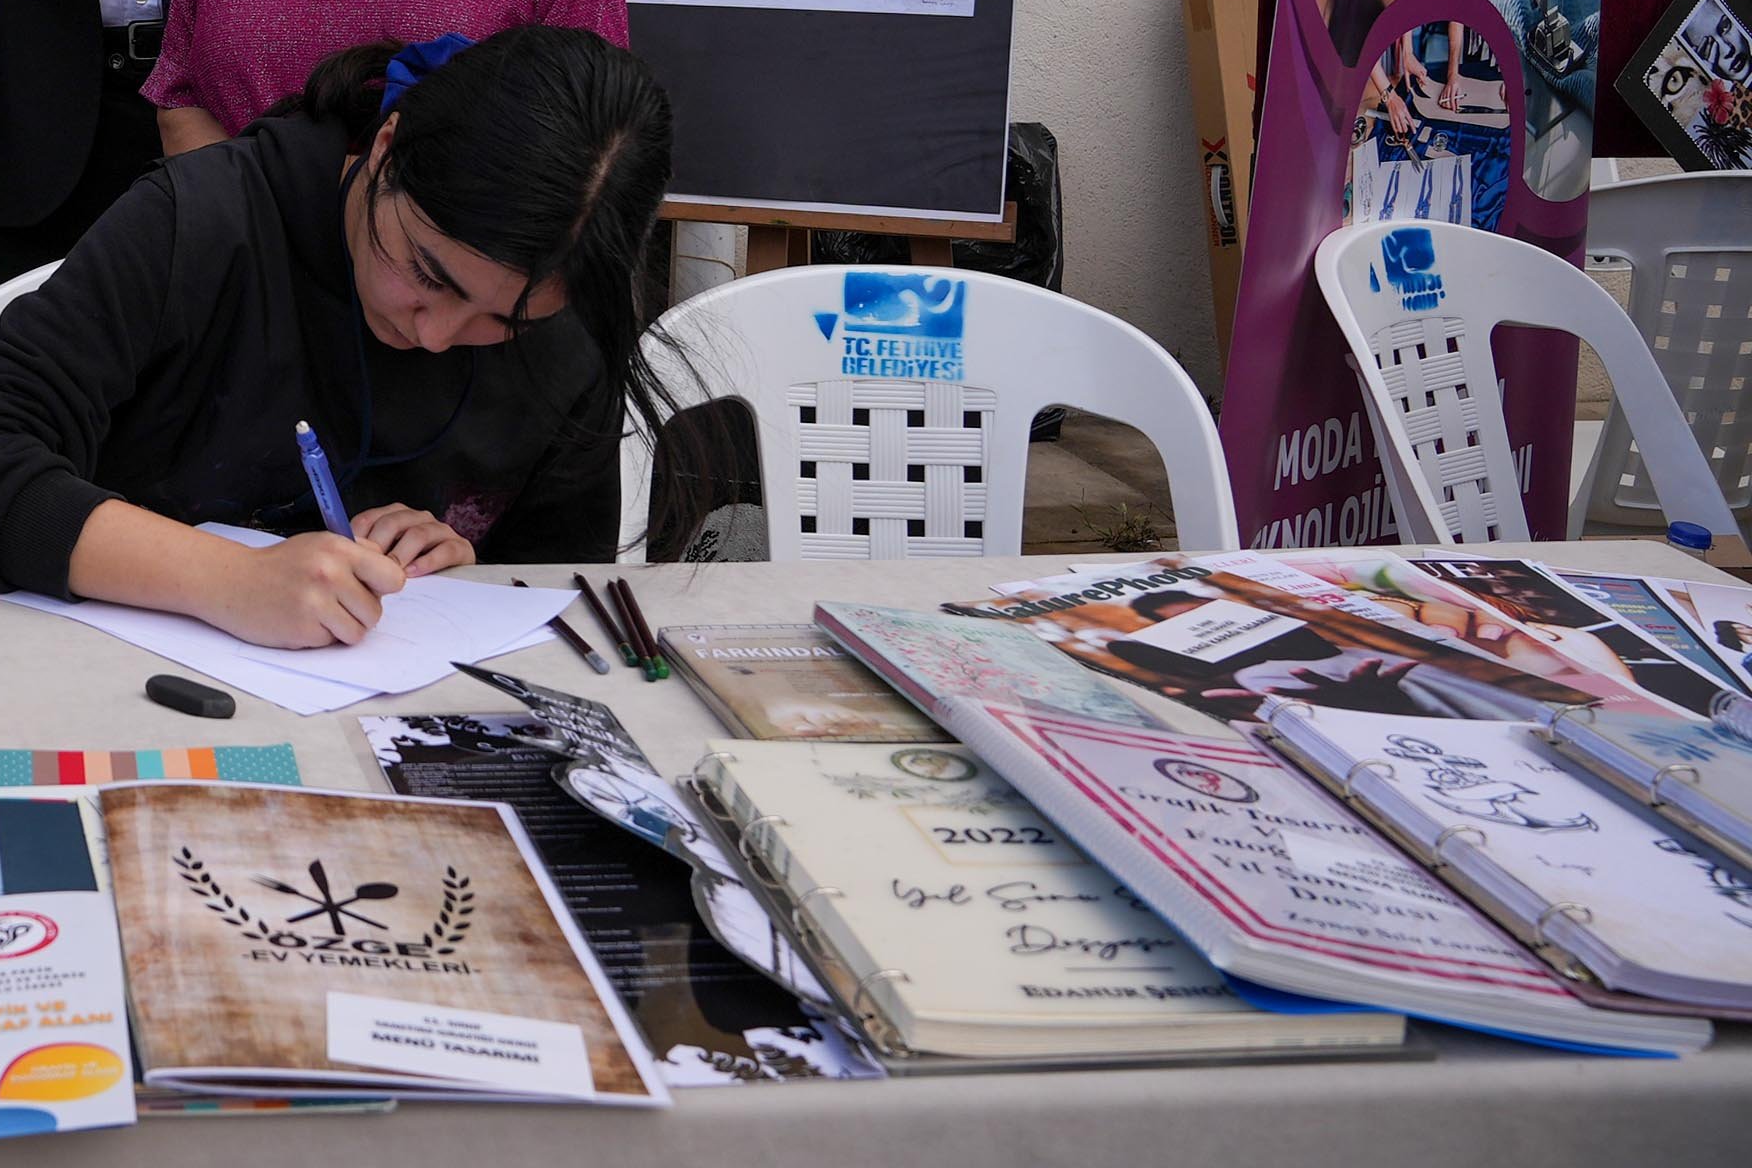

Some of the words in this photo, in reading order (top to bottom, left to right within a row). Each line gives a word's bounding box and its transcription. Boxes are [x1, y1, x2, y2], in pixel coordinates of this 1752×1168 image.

[1274, 412, 1363, 492] MODA
[972, 565, 1214, 621] NaturePhoto
[693, 642, 846, 662] FARKINDAL
[1118, 784, 1229, 817] Grafik
[934, 826, 1054, 845] 2022
[1290, 885, 1441, 923] Dosyası
[268, 927, 434, 959] ÖZGE
[371, 1030, 436, 1050] MENÜ
[439, 1040, 540, 1064] TASARIMI
